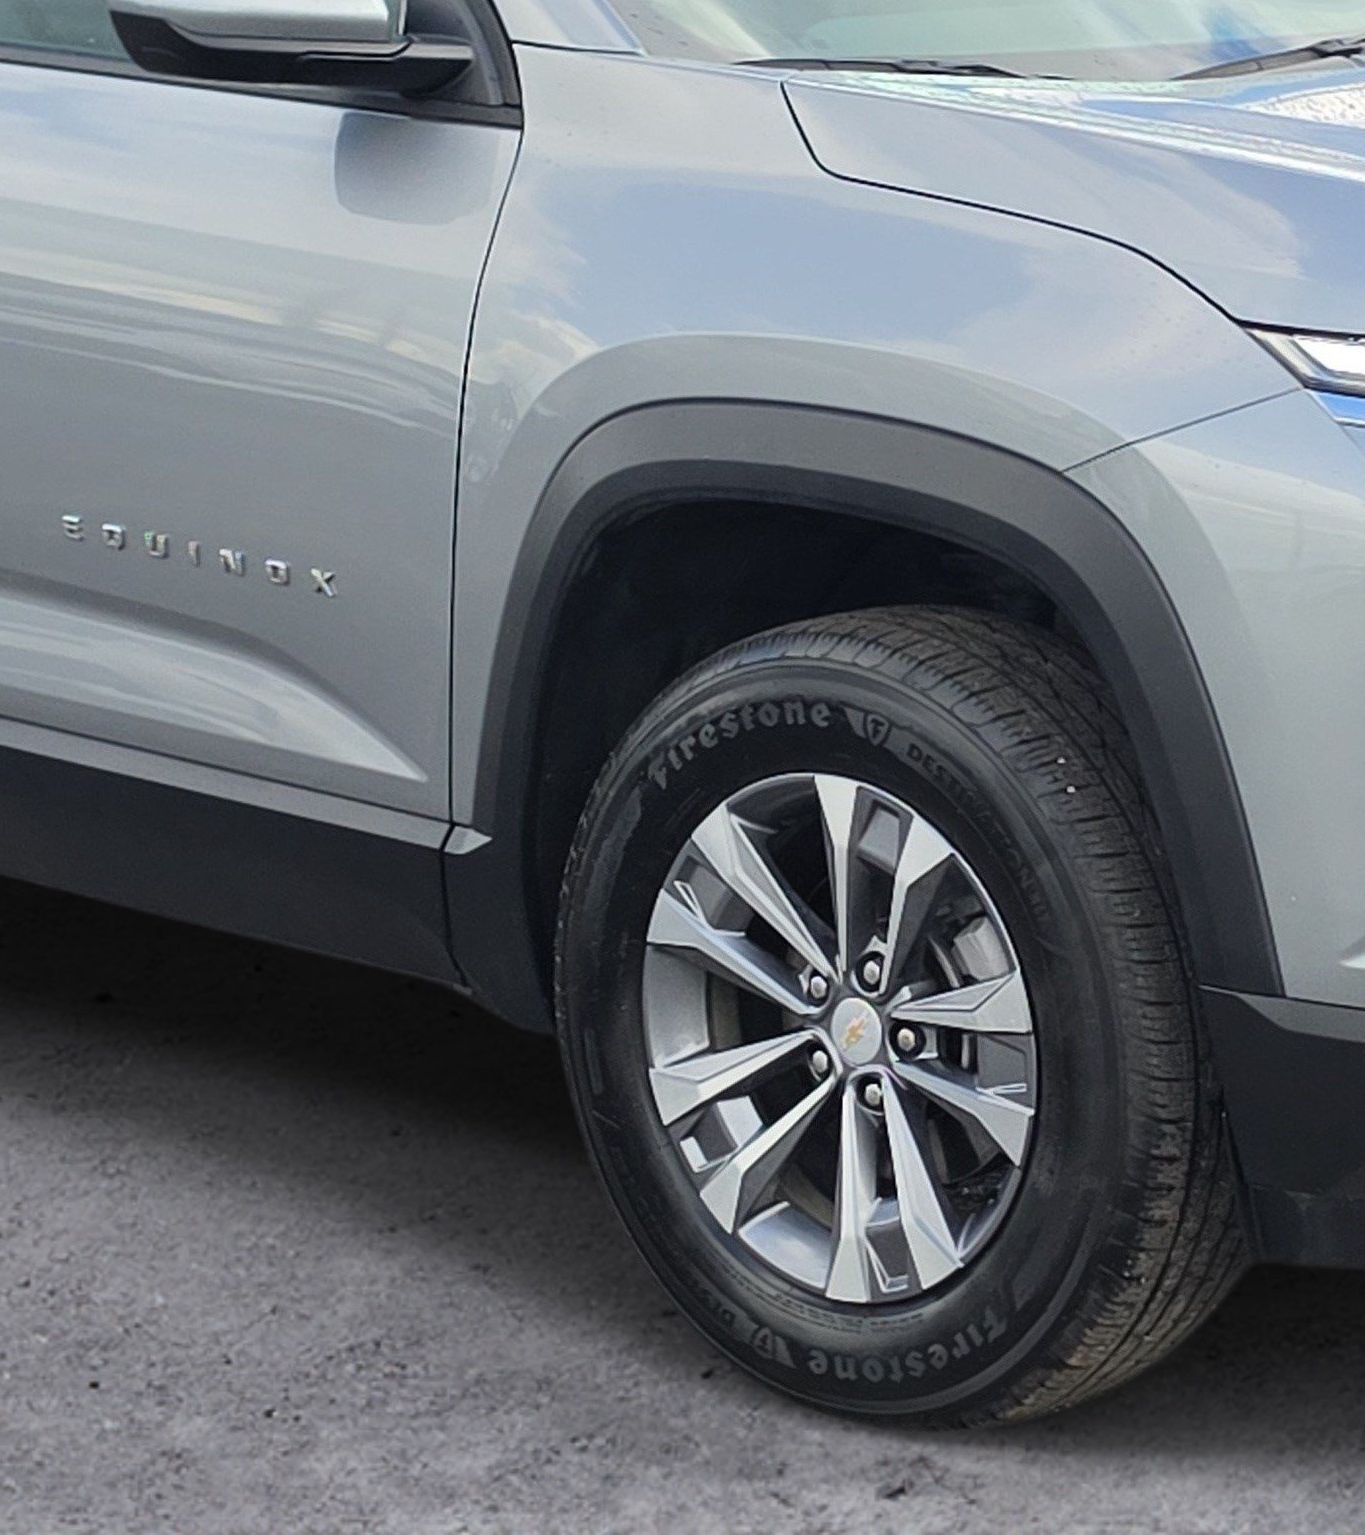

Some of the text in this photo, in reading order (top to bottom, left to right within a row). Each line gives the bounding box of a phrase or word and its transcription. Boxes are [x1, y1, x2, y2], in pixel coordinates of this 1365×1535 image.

[61, 514, 337, 598] EQUINOX
[648, 701, 832, 790] Firestone
[807, 1306, 1008, 1384] Firestone
